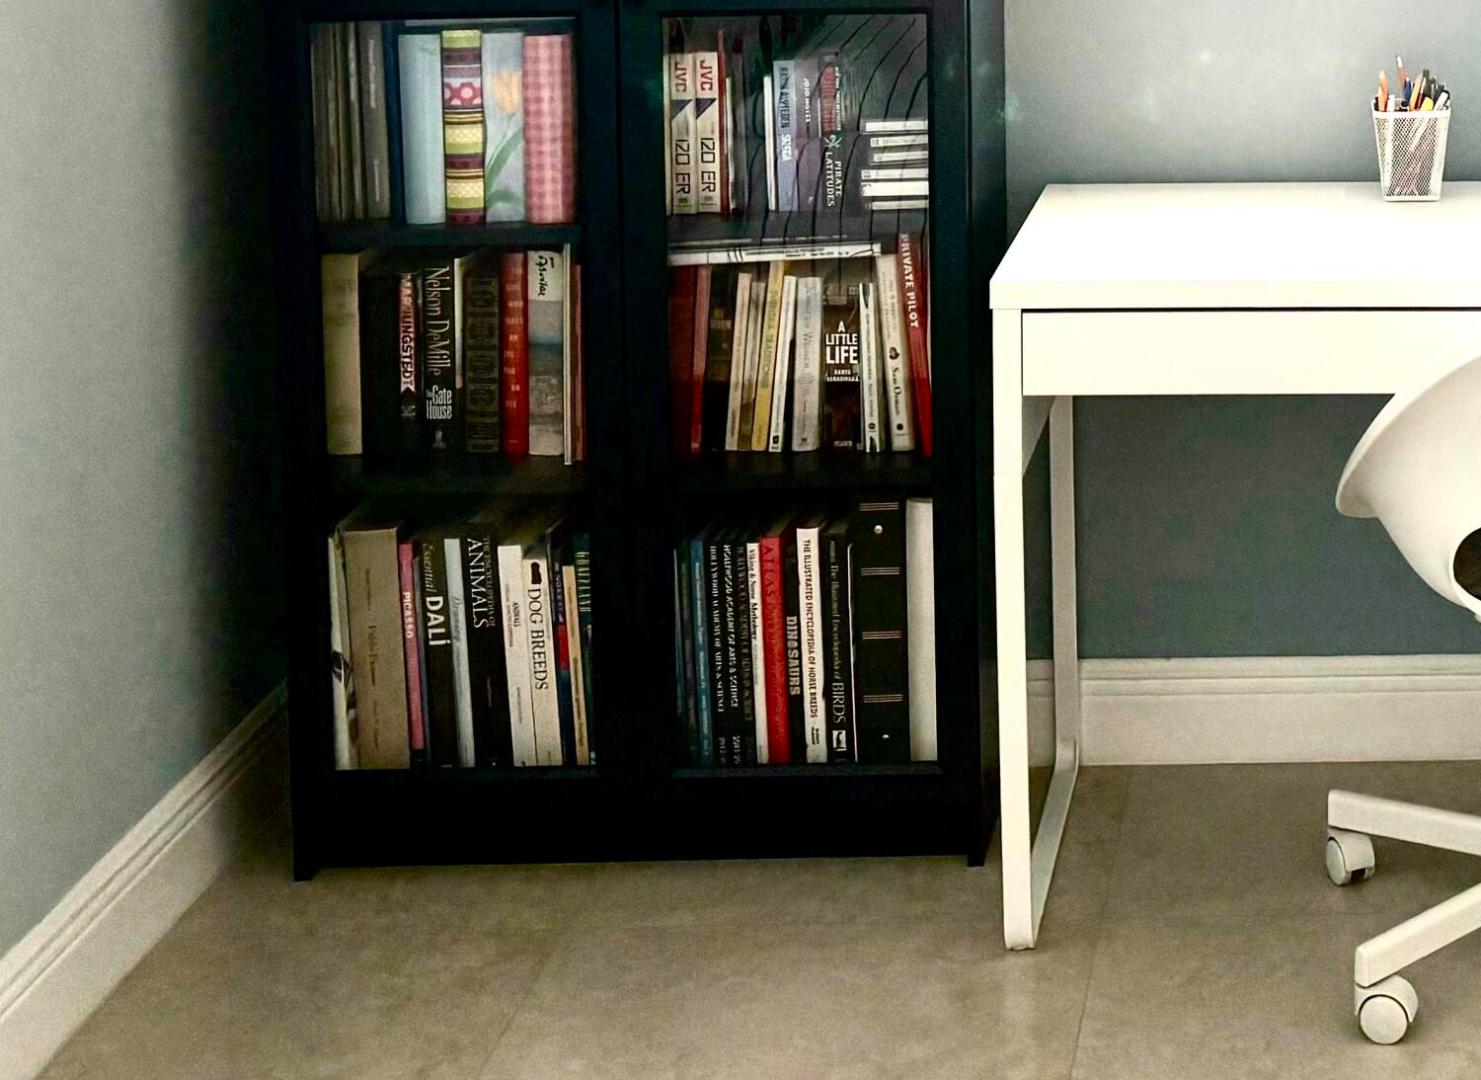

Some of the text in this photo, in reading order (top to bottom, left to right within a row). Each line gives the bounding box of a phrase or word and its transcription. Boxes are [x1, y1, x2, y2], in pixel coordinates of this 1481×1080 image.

[675, 61, 687, 92] JVC
[700, 60, 713, 91] JVC
[675, 140, 690, 194] 120 ER
[701, 138, 715, 192] 120 ER
[825, 152, 836, 207] LATITUDES
[835, 161, 843, 197] PIRATE
[900, 233, 919, 328] PRIVATE PILOT
[425, 266, 451, 376] Nelson DeMille
[825, 333, 858, 345] LITTLE
[837, 320, 845, 332] A
[826, 346, 858, 364] LIFE
[426, 399, 452, 419] House
[432, 385, 452, 404] Gate
[803, 540, 812, 553] THE
[467, 538, 488, 628] ANIMALS
[803, 555, 813, 601] ILLUSTRATED
[402, 591, 413, 639] PICASSO
[806, 602, 815, 654] ENCYCLOPEDIA
[527, 588, 549, 690] DOG BREEDS
[786, 615, 801, 696] DINOSAURS
[808, 656, 816, 665] OF
[809, 667, 817, 690] HORSE
[809, 692, 819, 718] BREEDS
[832, 682, 846, 724] BIRDS
